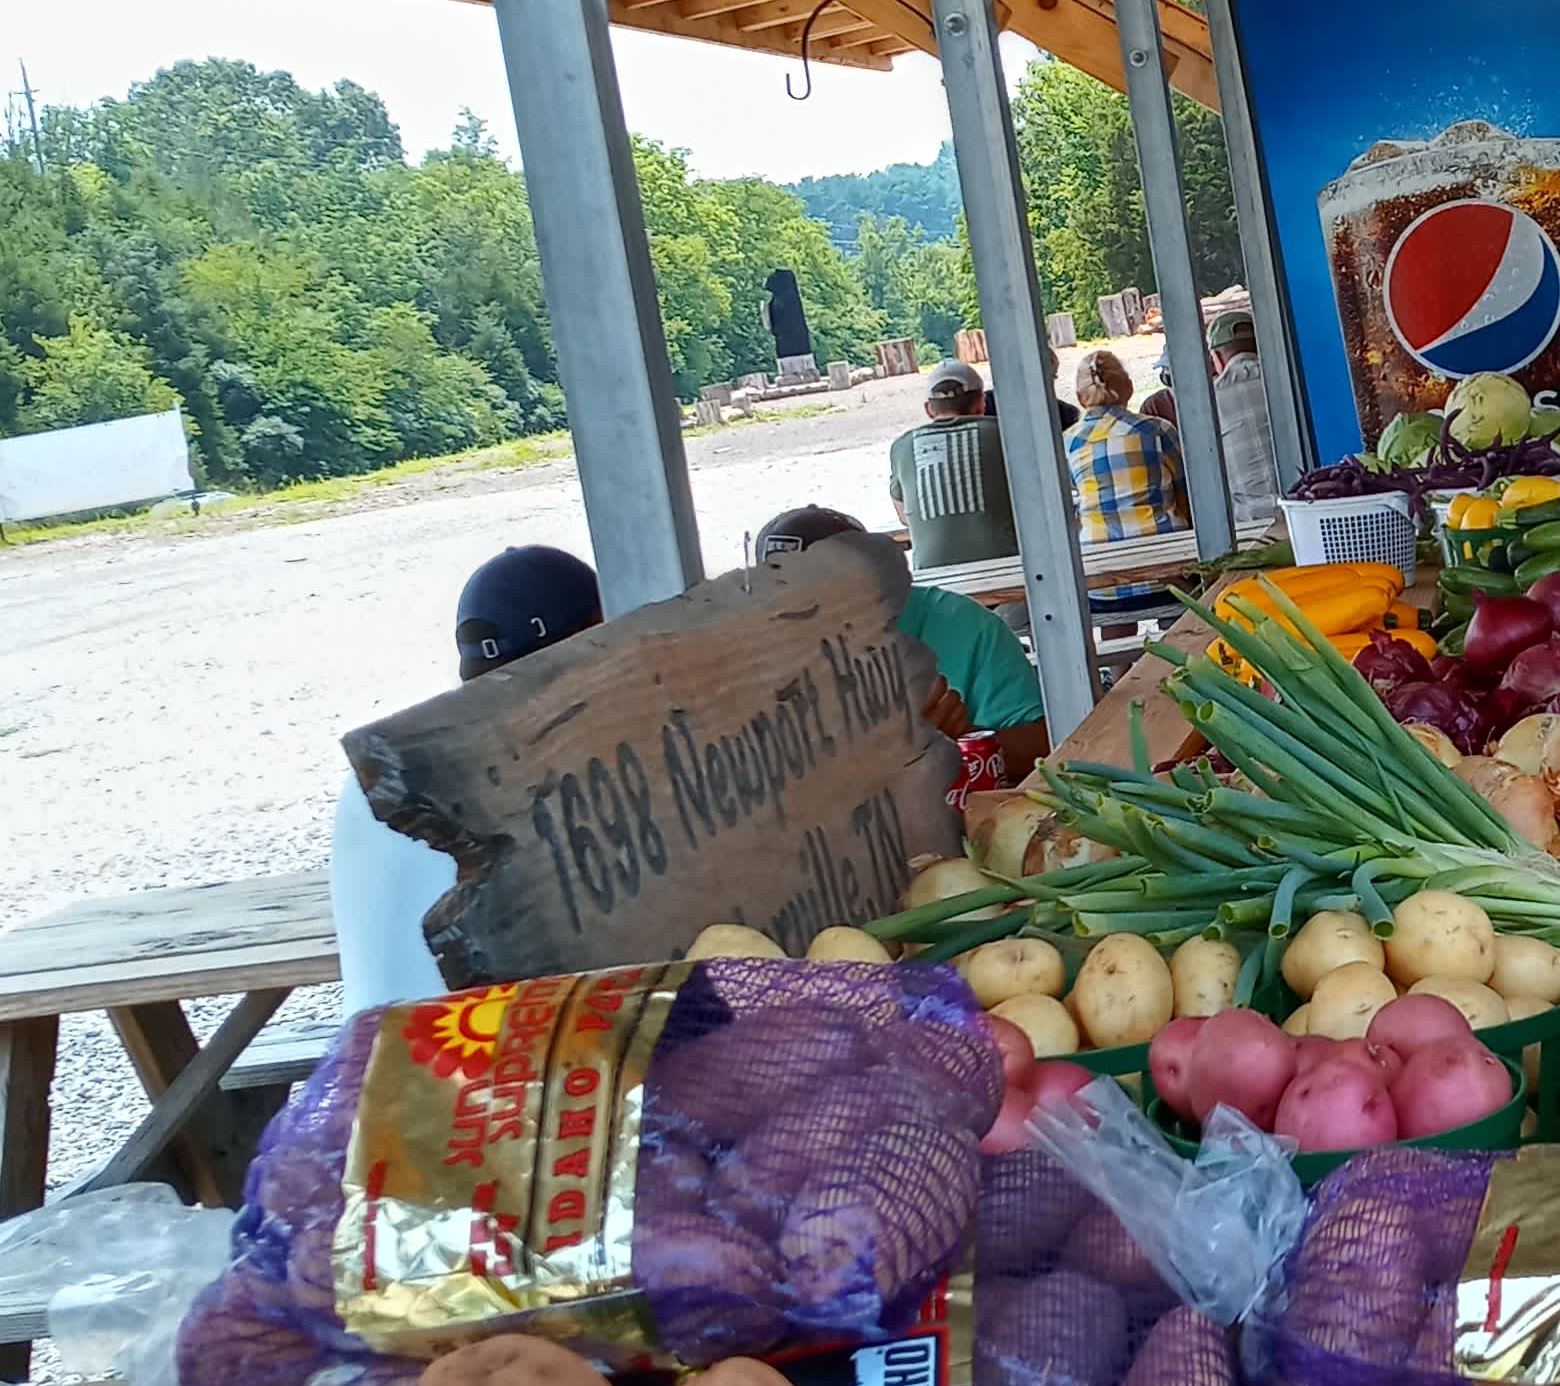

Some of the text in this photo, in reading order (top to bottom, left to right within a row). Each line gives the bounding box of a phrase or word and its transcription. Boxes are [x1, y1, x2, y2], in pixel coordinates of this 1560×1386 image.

[531, 633, 915, 935] 1698 Newport Hwy
[545, 1067, 601, 1254] IDAHO
